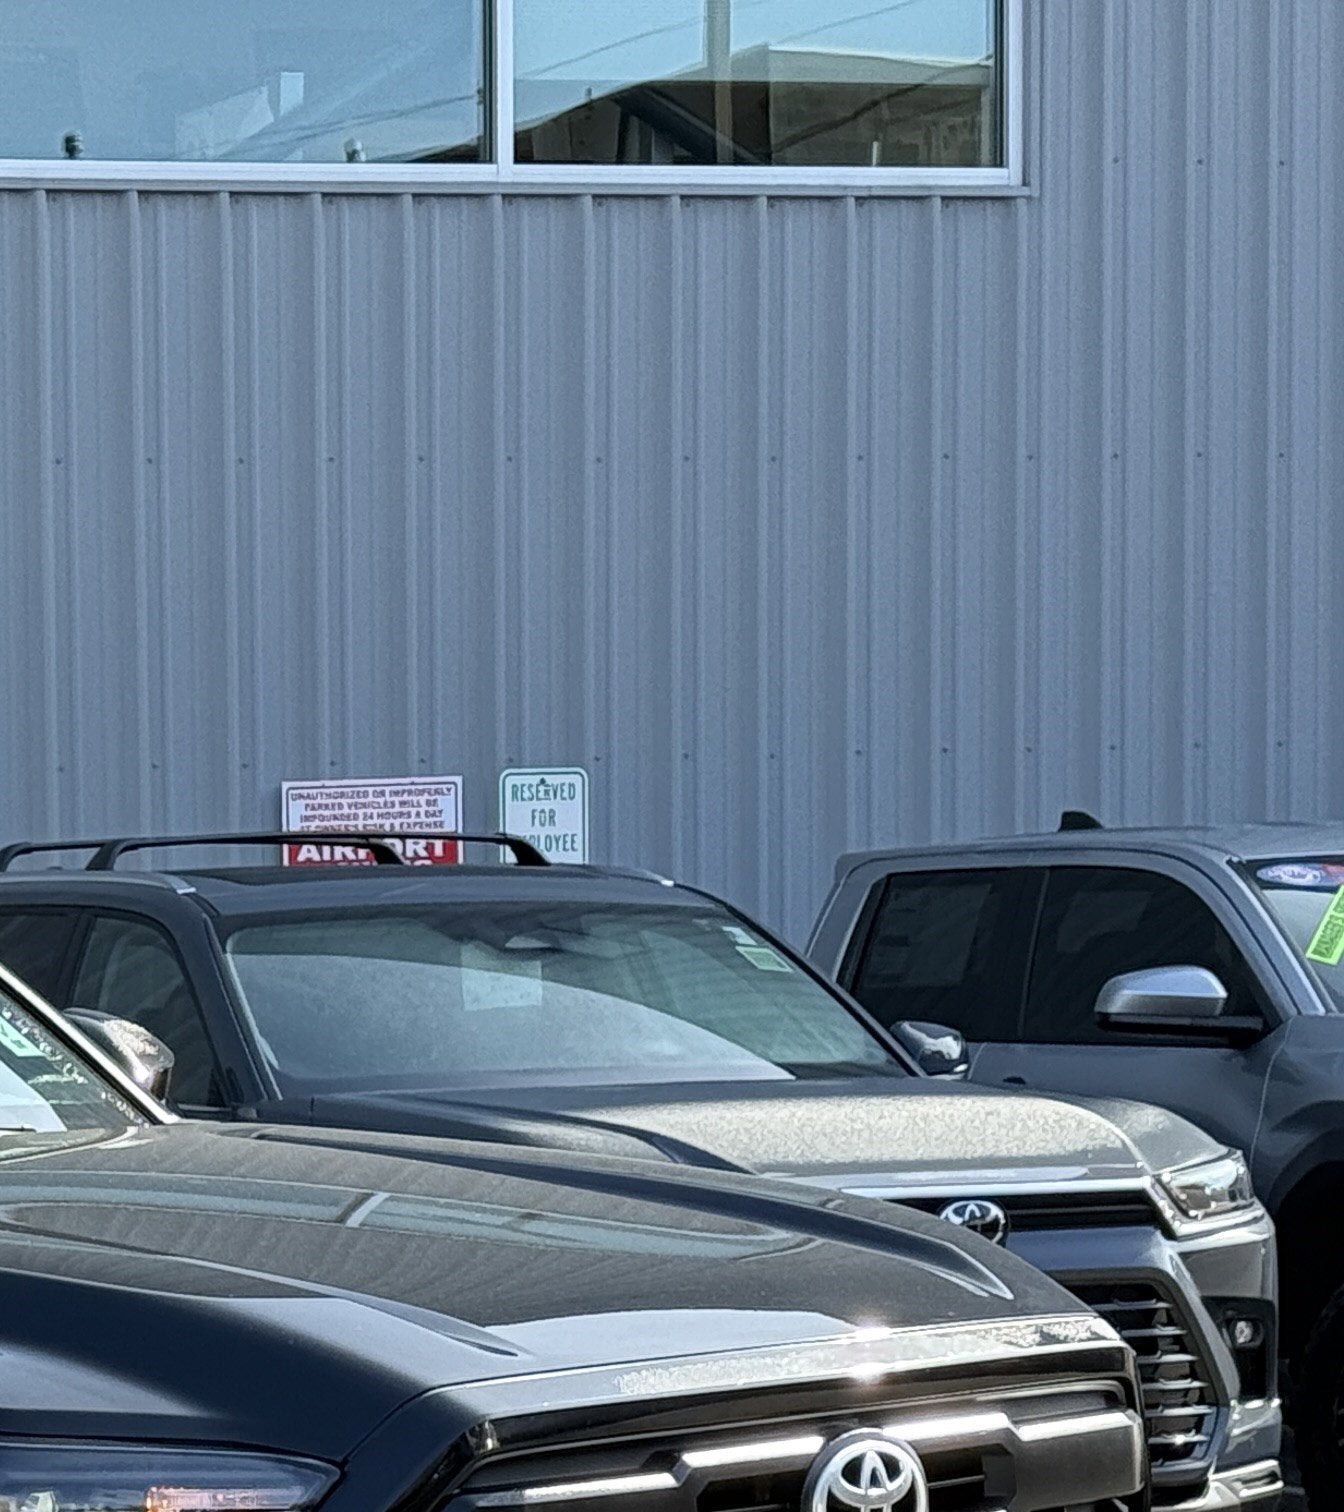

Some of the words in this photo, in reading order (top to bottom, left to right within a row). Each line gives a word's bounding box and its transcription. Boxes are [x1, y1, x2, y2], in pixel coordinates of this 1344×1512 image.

[291, 789, 369, 801] UNAUTHORIZED
[372, 789, 386, 798] OR
[389, 787, 452, 798] IMPROPERLY
[511, 782, 576, 802] RESERVED
[304, 801, 344, 811] PARKED
[347, 800, 395, 810] VEHICLES
[399, 799, 423, 809] WILL
[426, 798, 439, 808] BE
[299, 813, 359, 823] IMPOUNDED
[363, 811, 374, 822] 24
[376, 810, 411, 821] HOURS
[414, 810, 421, 819] A
[425, 809, 444, 818] DAY
[531, 808, 556, 827] FOR
